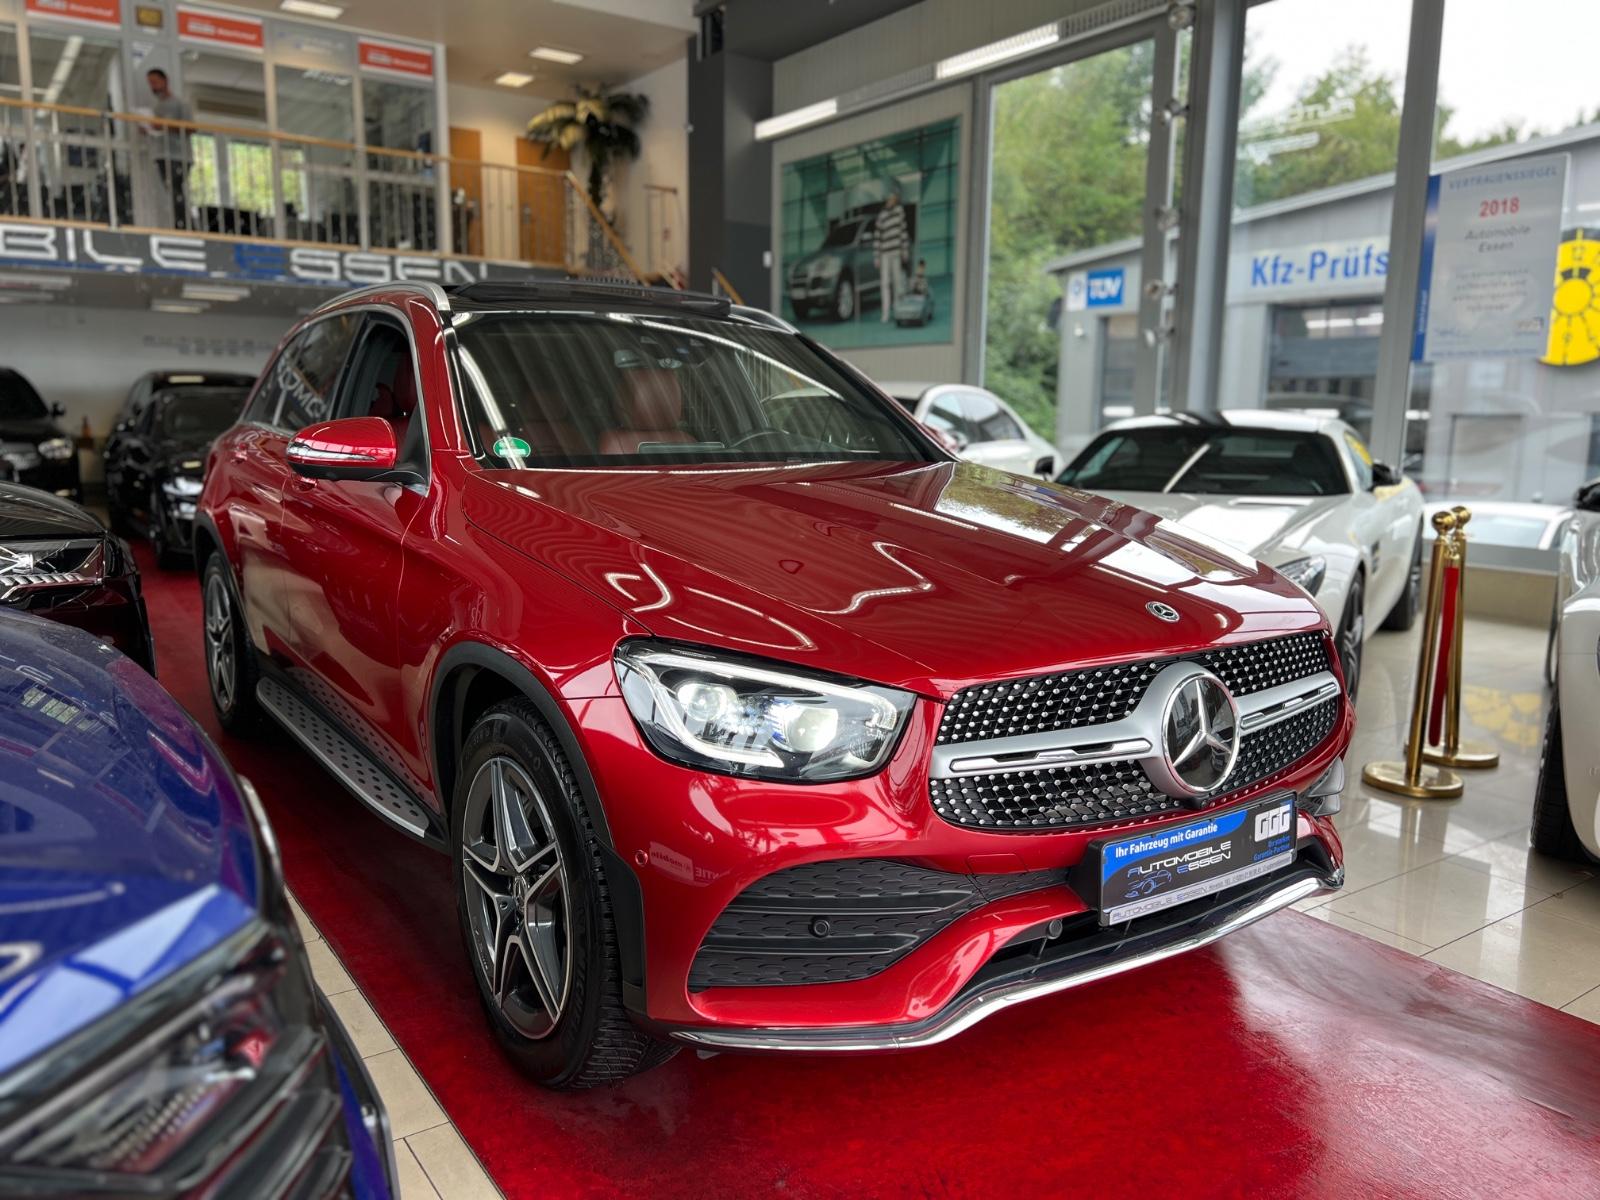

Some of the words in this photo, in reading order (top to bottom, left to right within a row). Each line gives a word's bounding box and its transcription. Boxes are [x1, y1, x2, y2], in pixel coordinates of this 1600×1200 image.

[1479, 196, 1520, 218] 2018
[1464, 225, 1531, 240] Automobile
[0, 223, 207, 271] BILE
[233, 243, 488, 285] ESSEN
[1478, 241, 1514, 253] Essen
[1115, 846, 1128, 858] Ihr
[1130, 837, 1169, 855] Fahrzeug
[1170, 831, 1184, 844] mit
[1185, 822, 1218, 840] Garantie
[1127, 840, 1232, 879] AUTOMOBILE
[1176, 850, 1232, 874] ESSEN
